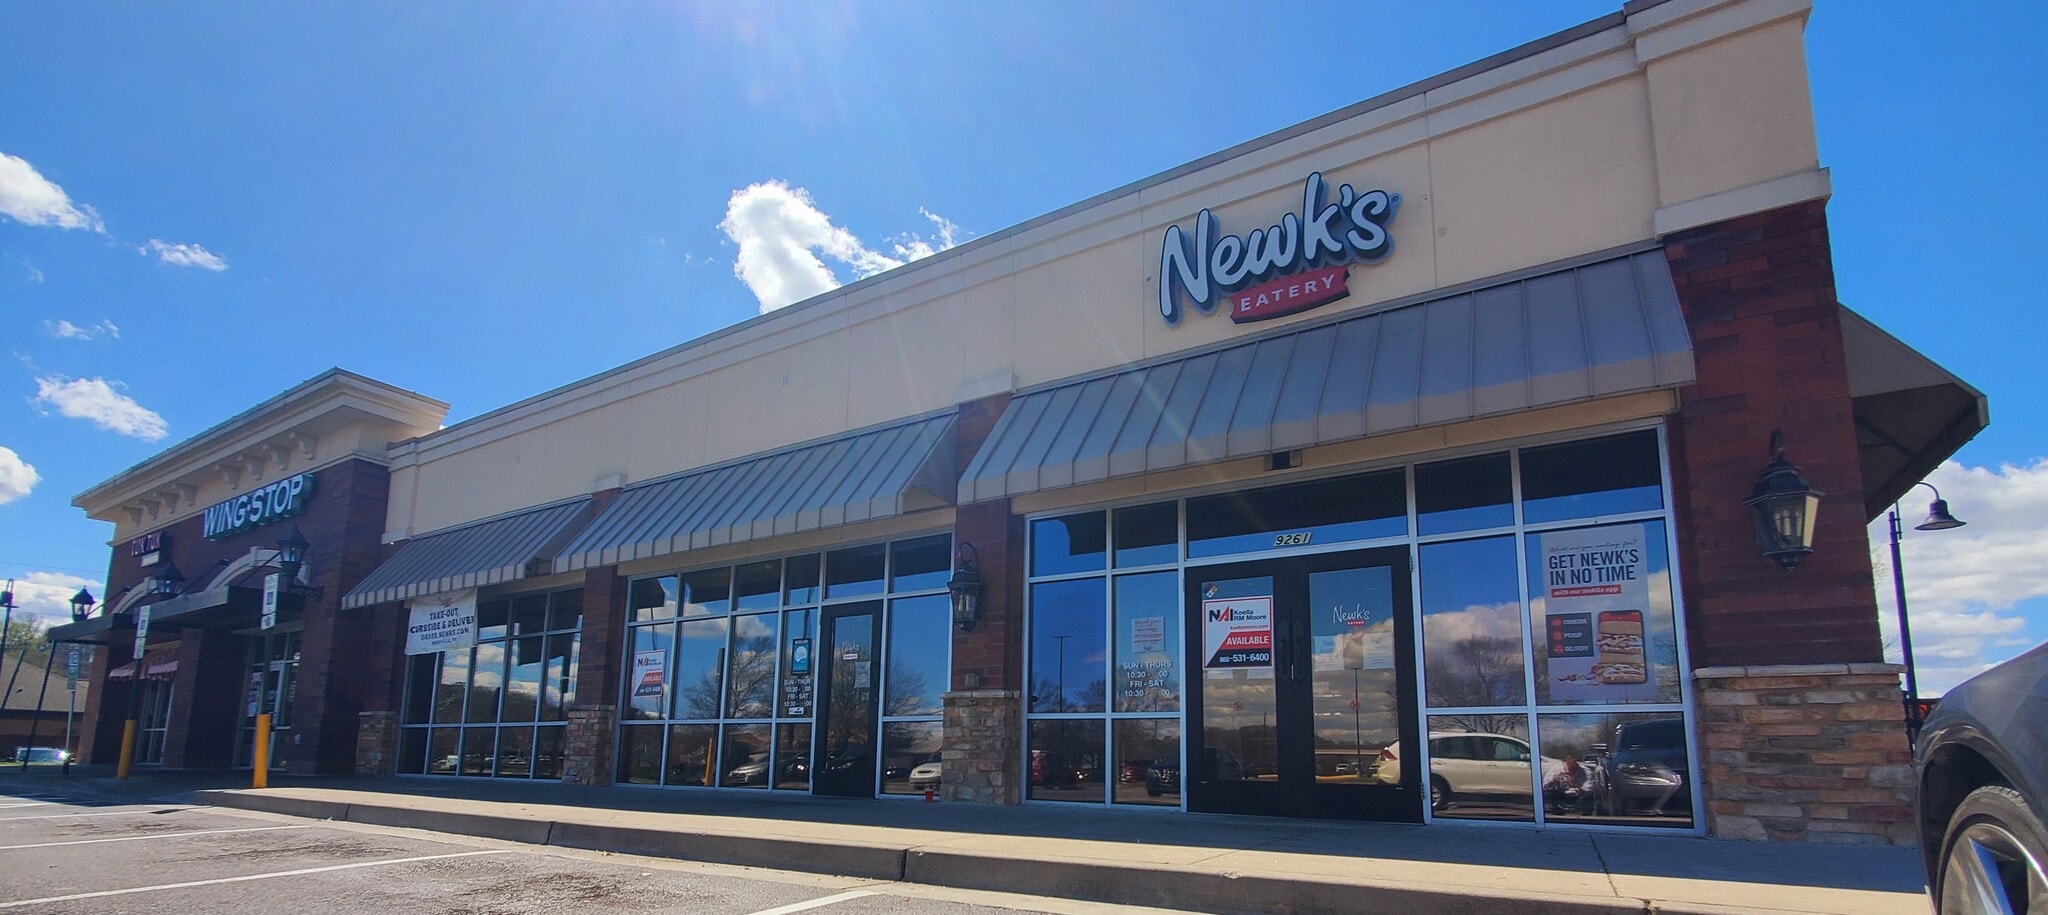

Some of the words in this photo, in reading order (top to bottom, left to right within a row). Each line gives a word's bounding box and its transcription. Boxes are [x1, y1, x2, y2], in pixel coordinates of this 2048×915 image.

[1159, 171, 1392, 319] Newk's
[1239, 273, 1336, 313] EATERY
[1276, 533, 1310, 545] 9261
[1549, 554, 1576, 569] GET
[1580, 549, 1639, 567] NEWK'S
[1550, 570, 1566, 585] IN
[1571, 568, 1592, 584] NO
[1595, 565, 1636, 582] TIME
[1209, 606, 1233, 622] NAI
[1333, 603, 1370, 624] Newk's
[1226, 635, 1269, 645] AVAILABLE
[1123, 662, 1139, 670] SUN
[1145, 660, 1173, 669] THURS
[1126, 671, 1146, 679] 10:30
[1130, 680, 1143, 688] FRI
